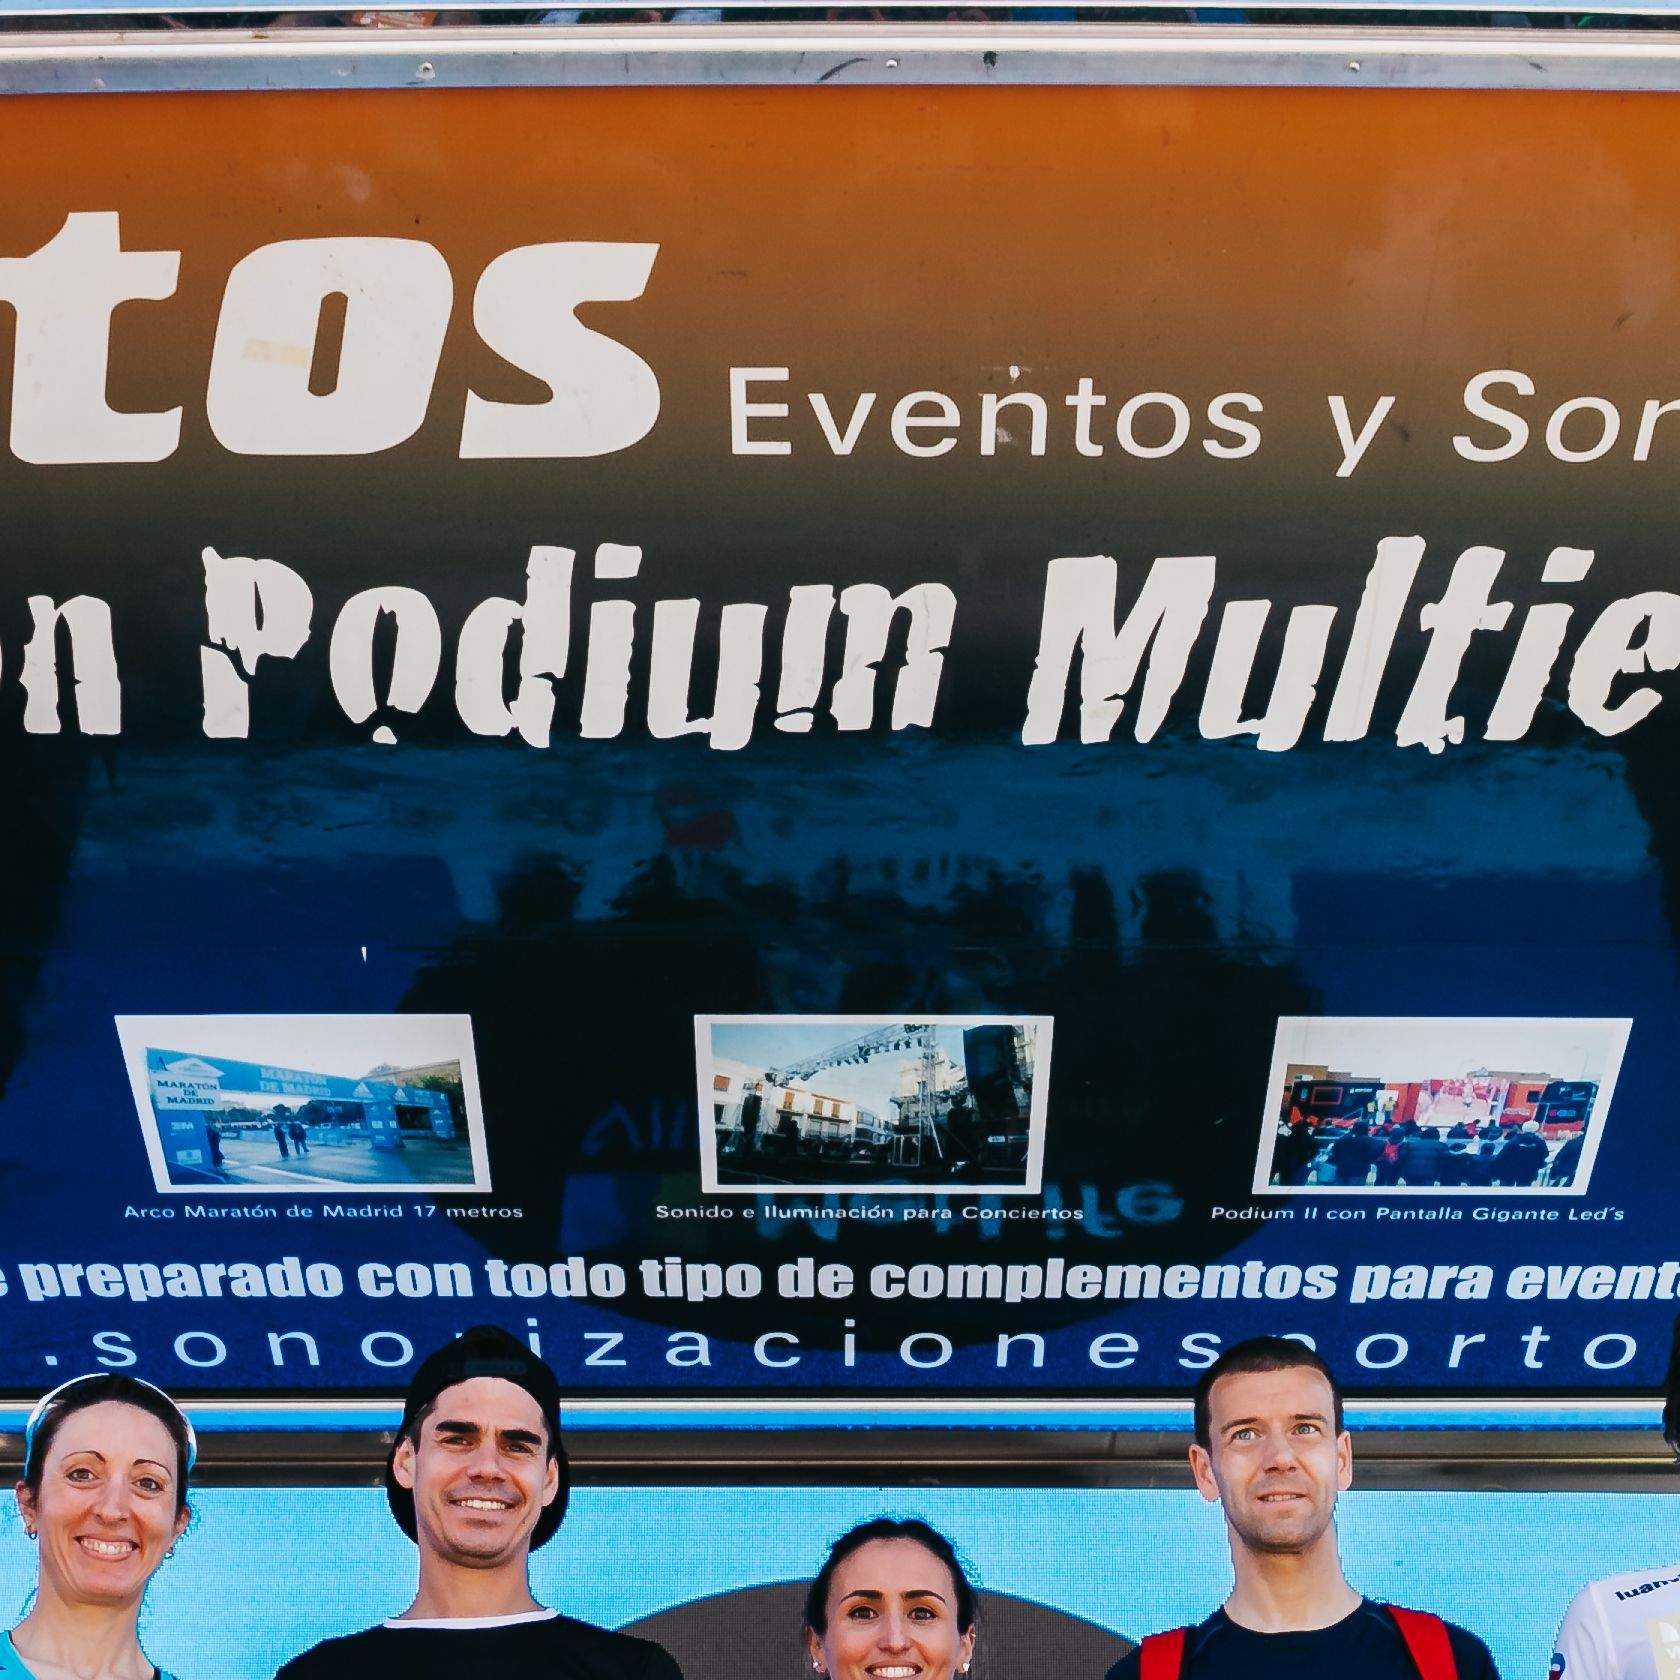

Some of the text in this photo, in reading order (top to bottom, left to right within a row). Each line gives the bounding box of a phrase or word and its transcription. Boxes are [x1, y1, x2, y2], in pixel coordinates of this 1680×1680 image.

[729, 366, 1264, 460] Eventos
[1327, 395, 1396, 477] y
[200, 543, 958, 751] Podium
[124, 1204, 523, 1218] Arco Maratón de Madrid 17 metros
[656, 1204, 1084, 1221] Sonido e Iluminación para Conciertos
[1211, 1206, 1294, 1220] Podium
[1304, 1207, 1318, 1220] II
[1326, 1210, 1366, 1220] con
[1376, 1206, 1463, 1220] Pantalla
[1472, 1207, 1559, 1223] Gigante
[18, 1256, 344, 1302] preparado
[357, 1262, 473, 1298] con
[484, 1256, 626, 1298] todo
[639, 1256, 762, 1302] tipo
[777, 1257, 854, 1299] de
[870, 1258, 1339, 1303] complementos
[1349, 1264, 1494, 1304] para
